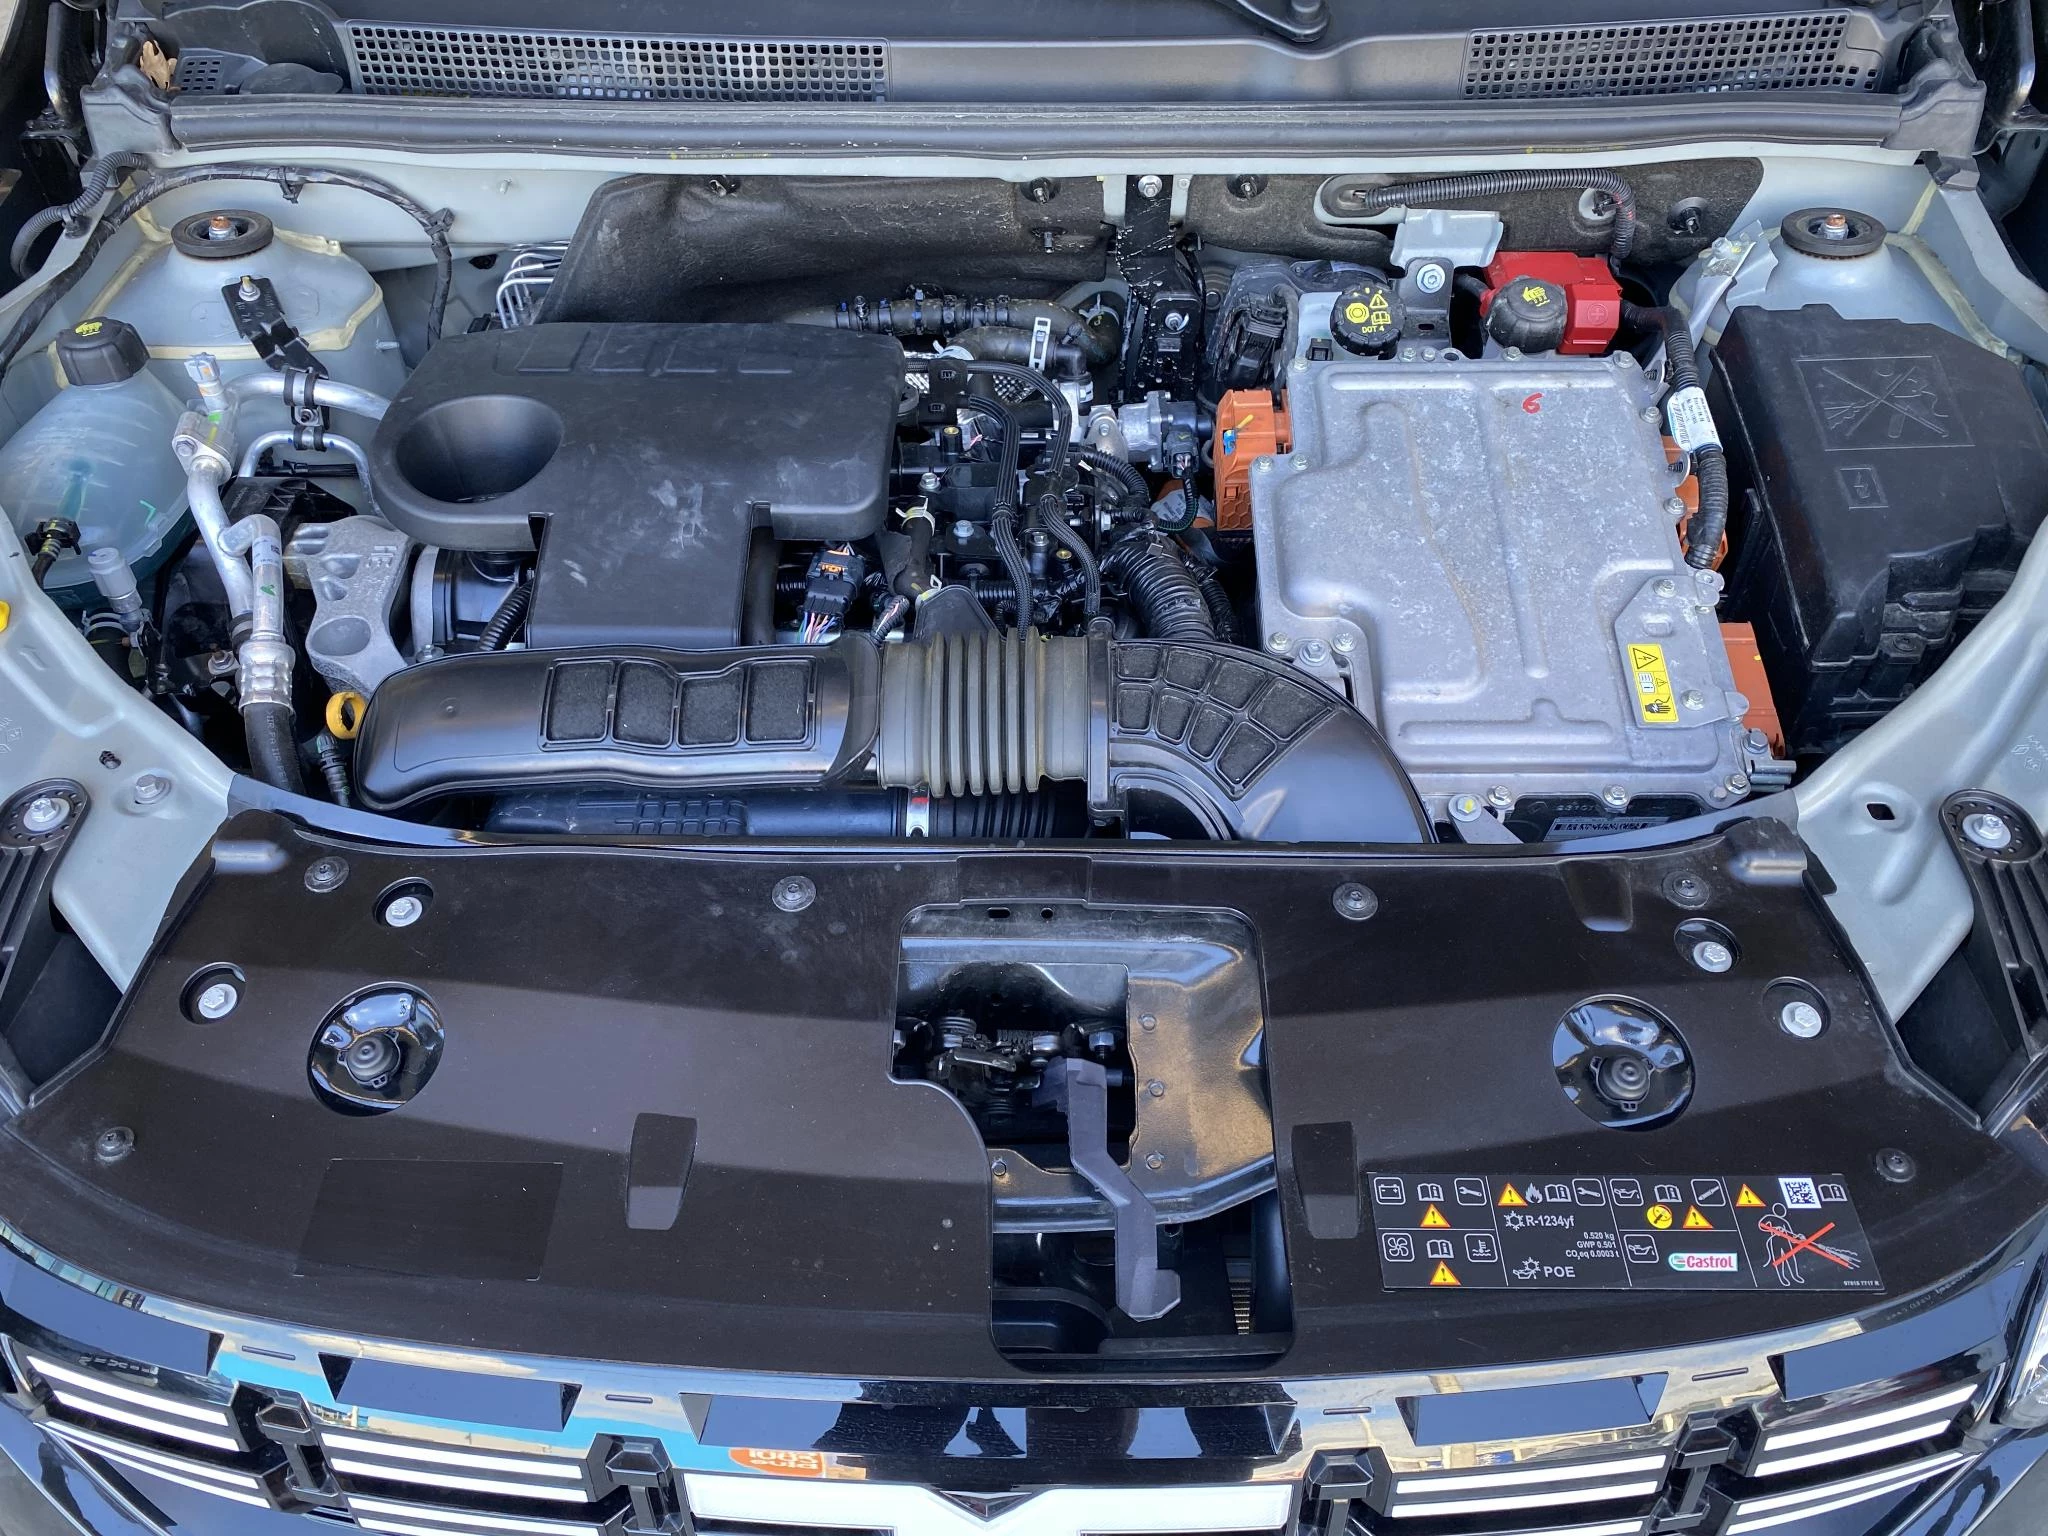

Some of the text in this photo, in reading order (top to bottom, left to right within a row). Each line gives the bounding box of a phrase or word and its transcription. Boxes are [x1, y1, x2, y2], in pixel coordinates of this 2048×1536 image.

[1522, 392, 1543, 414] 6
[1526, 1215, 1574, 1229] R-1234yf
[1583, 1231, 1615, 1241] 0.520 kg
[1576, 1240, 1617, 1249] GWP 0.501
[1590, 1249, 1614, 1258] 0.0003
[1614, 1250, 1620, 1258] t
[1686, 1255, 1733, 1269] Castrol
[1543, 1266, 1576, 1278] POE
